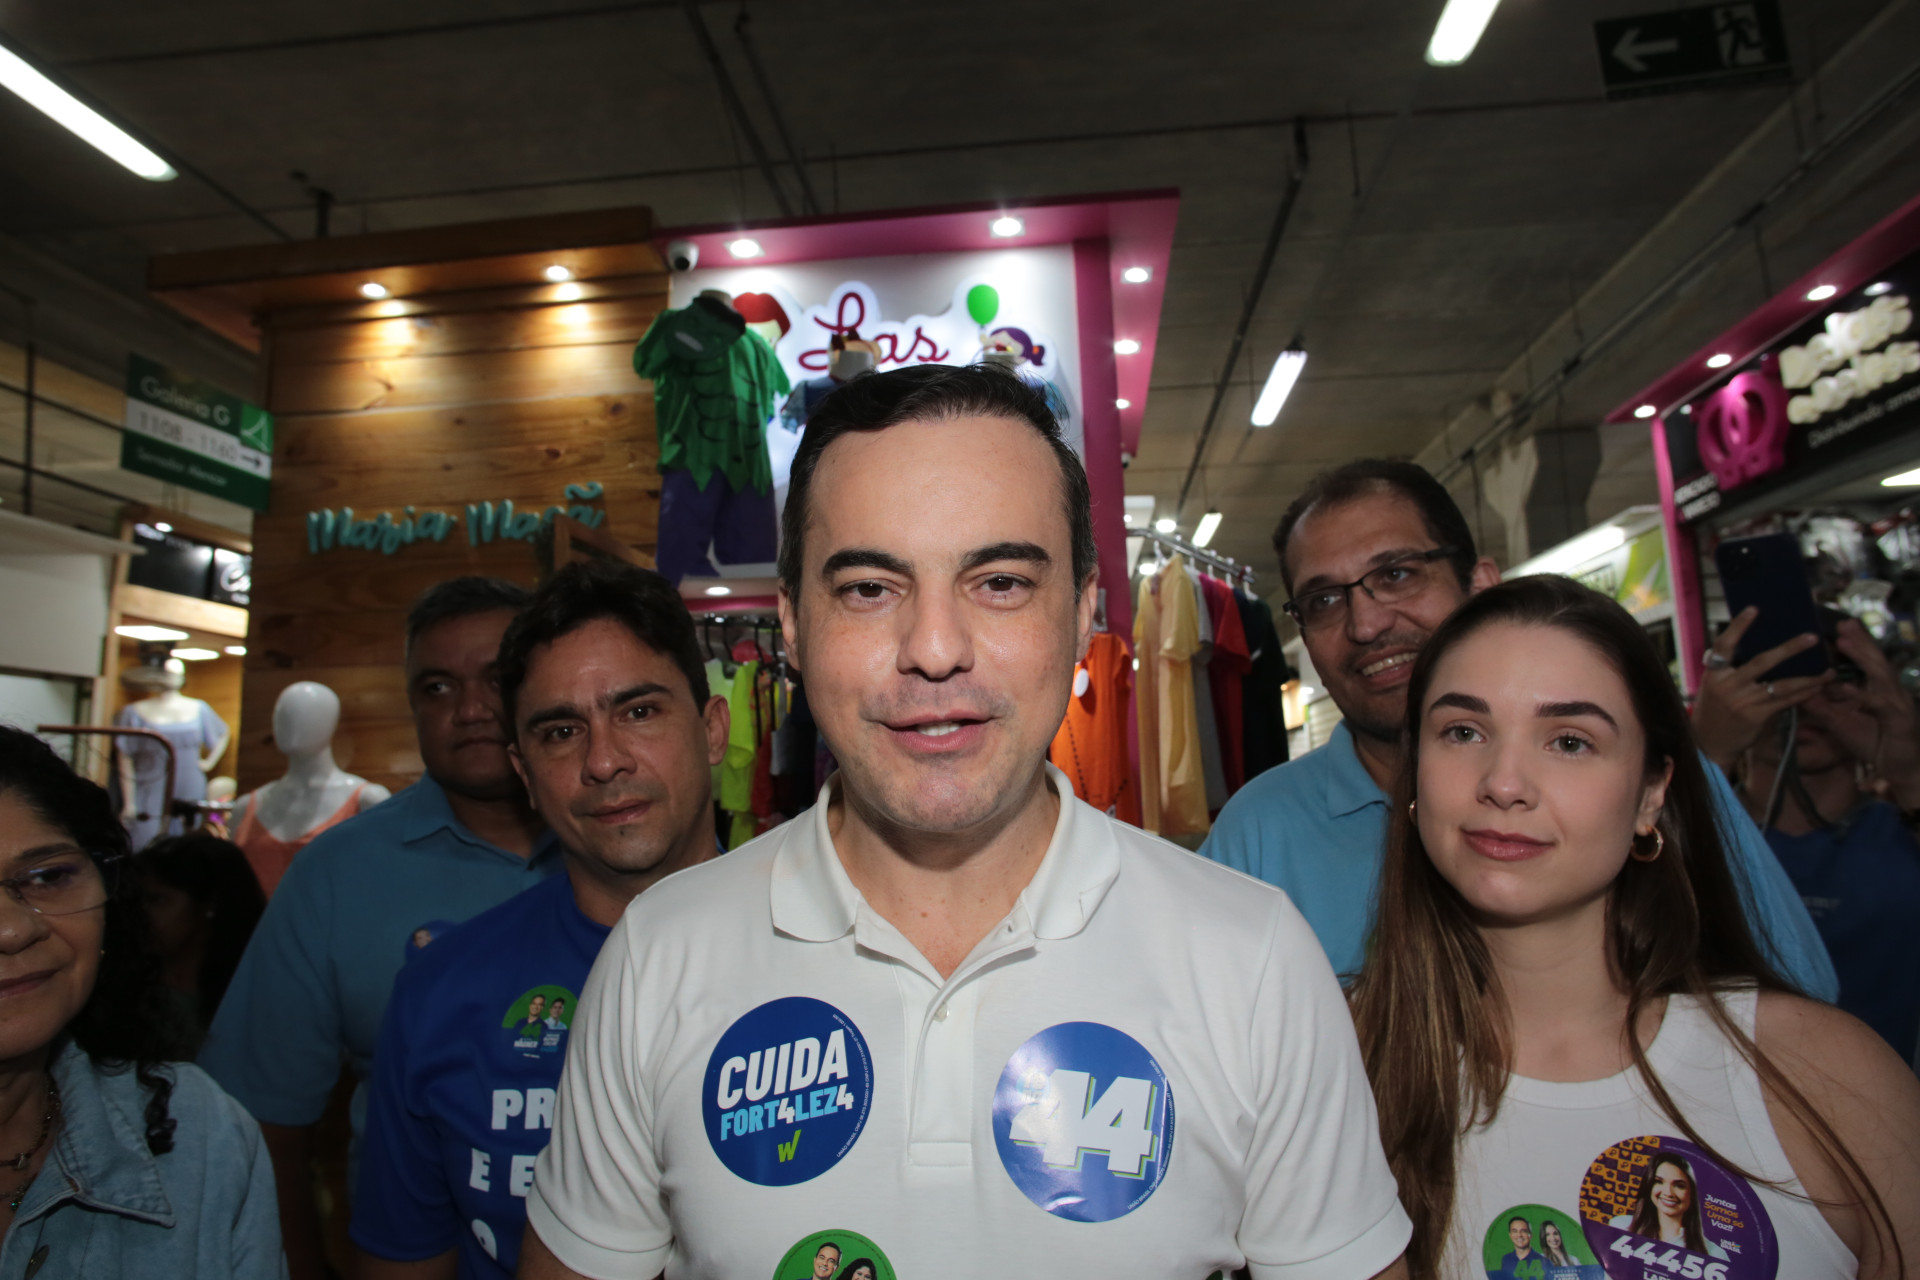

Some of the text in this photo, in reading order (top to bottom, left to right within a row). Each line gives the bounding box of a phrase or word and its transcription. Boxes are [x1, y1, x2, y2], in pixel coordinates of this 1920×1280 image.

[213, 404, 231, 426] G
[717, 1029, 849, 1110] CUIDA
[720, 1084, 854, 1141] FORT4LEZ4
[1009, 1068, 1159, 1181] 44
[469, 1148, 491, 1192] E
[1703, 1201, 1739, 1218] Somos
[1704, 1193, 1737, 1210] Juntas
[1706, 1210, 1731, 1224] Uma
[1610, 1234, 1730, 1280] 44456
